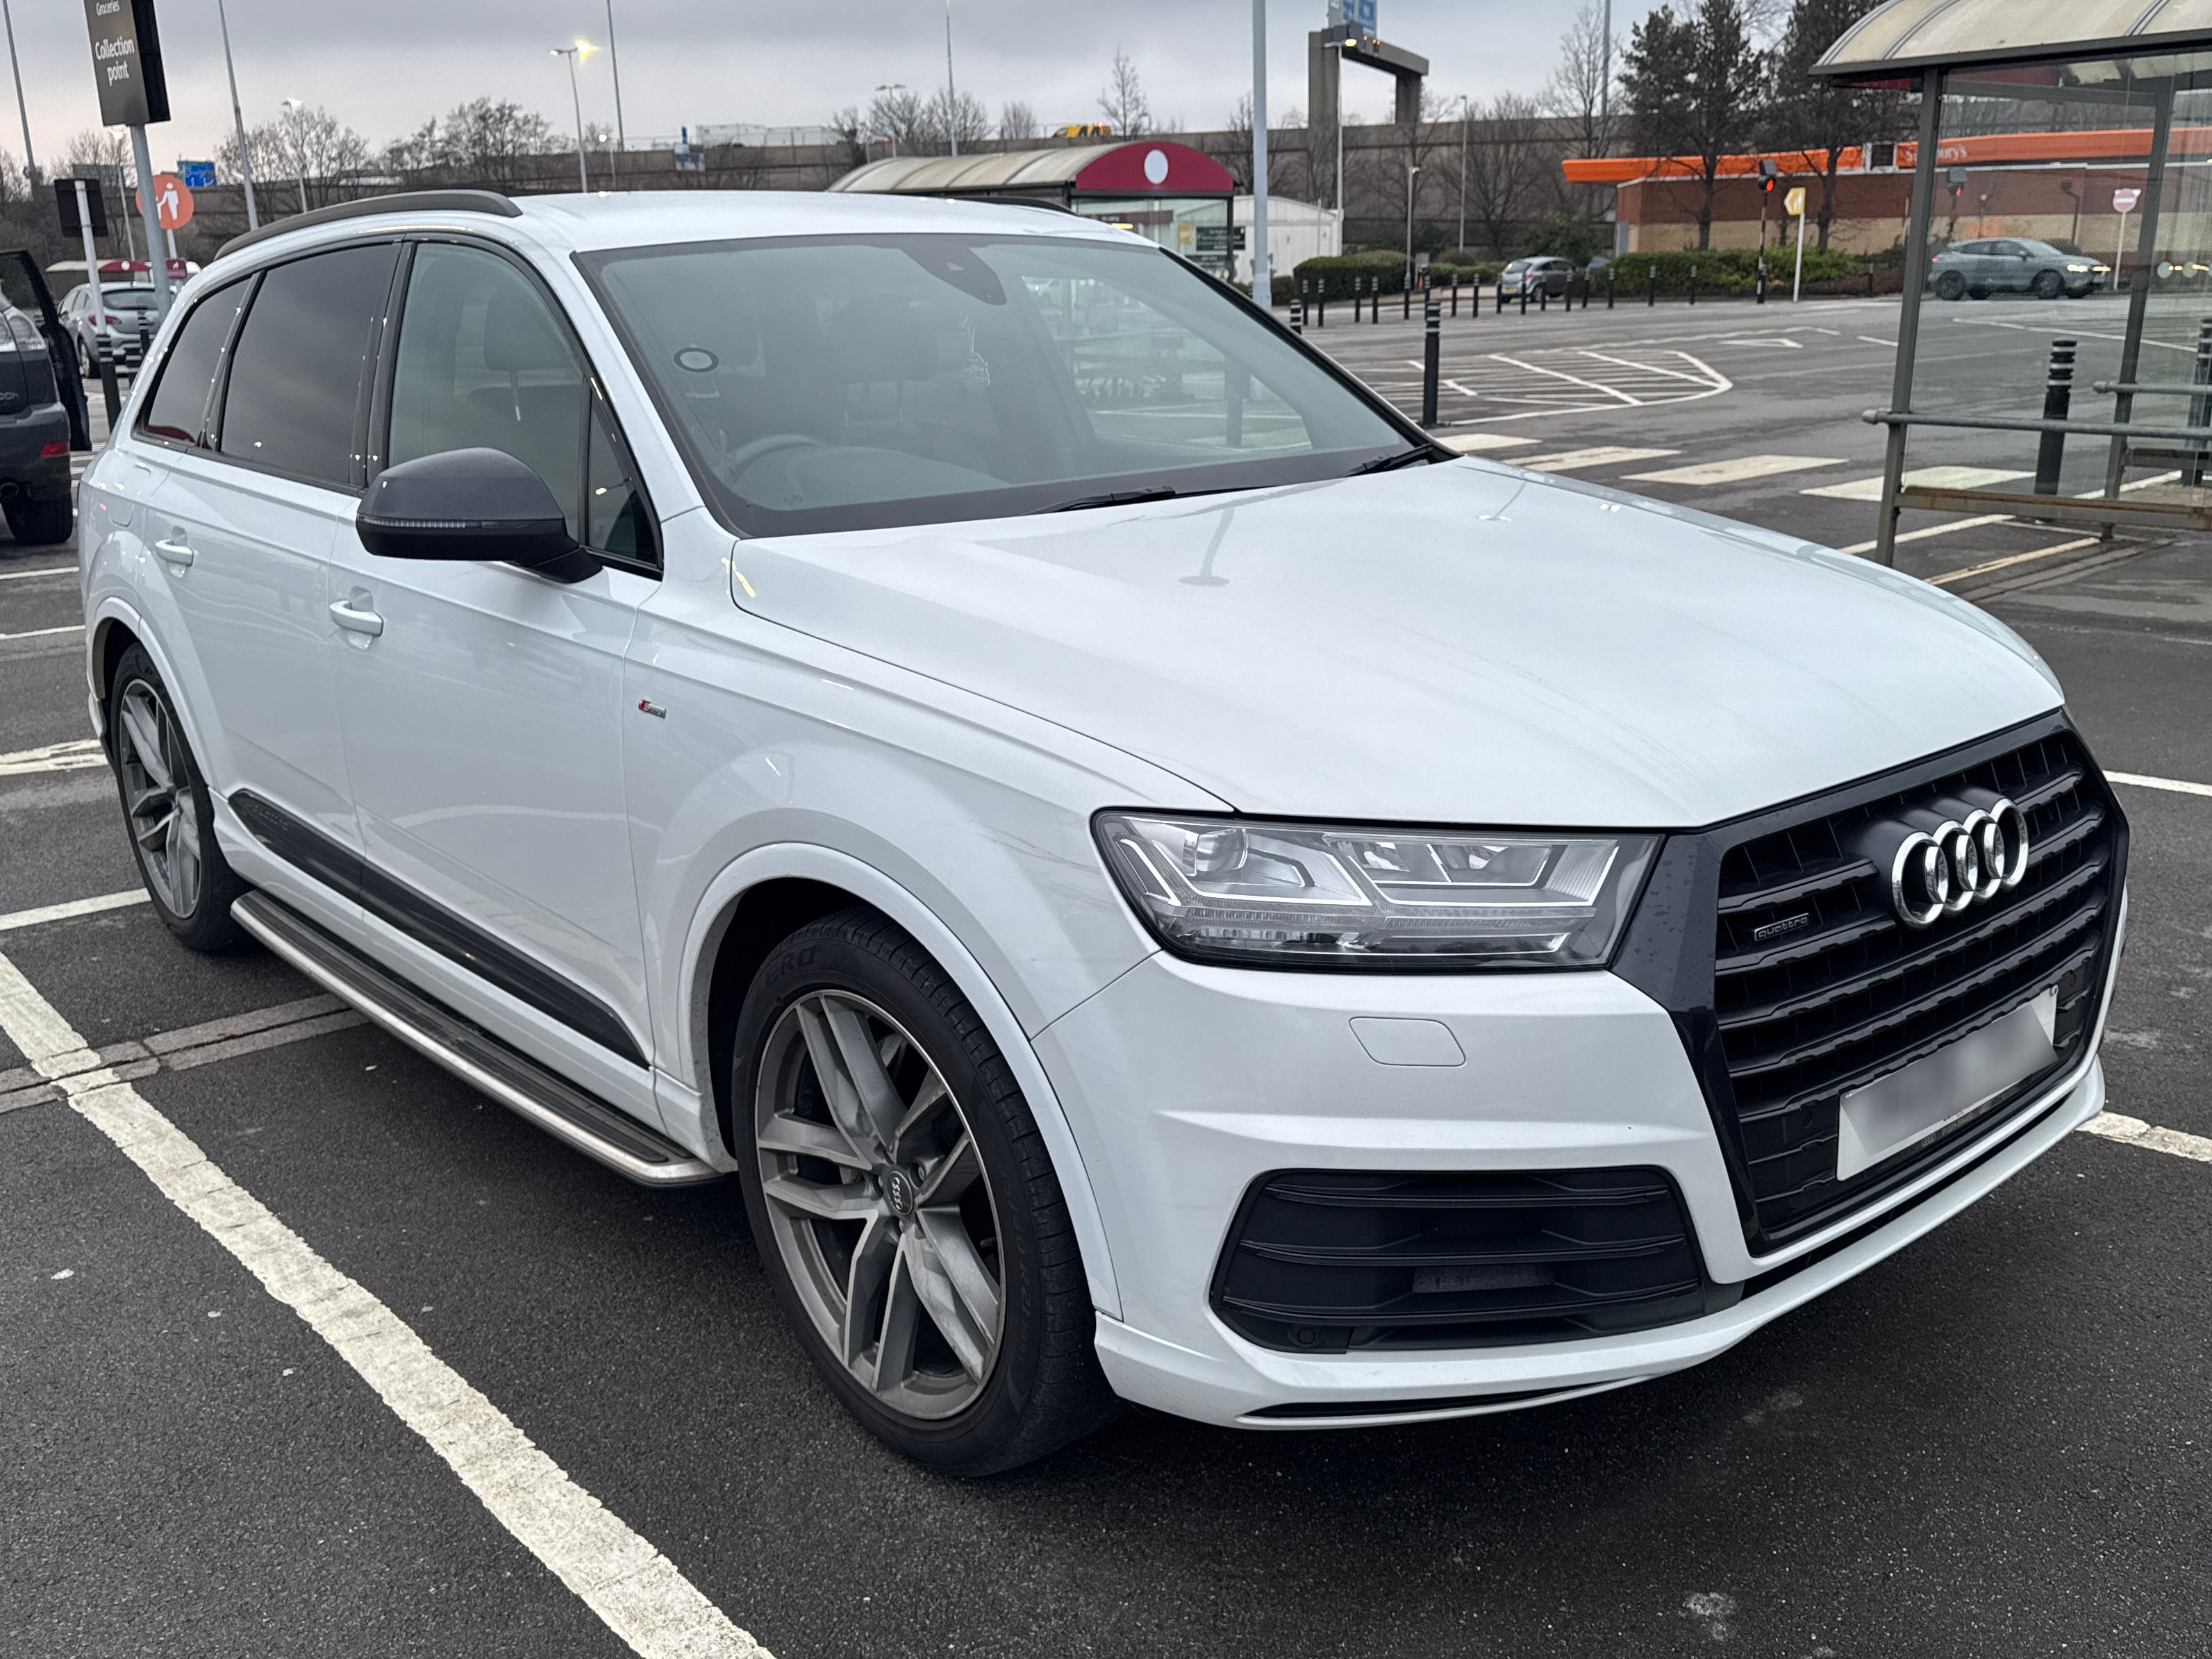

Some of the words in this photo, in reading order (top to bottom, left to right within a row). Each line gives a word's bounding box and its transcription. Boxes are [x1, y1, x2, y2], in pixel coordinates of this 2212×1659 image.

[96, 0, 120, 16] Groceries
[95, 36, 135, 60] Collection
[107, 60, 130, 87] point
[1758, 915, 1808, 938] quattro
